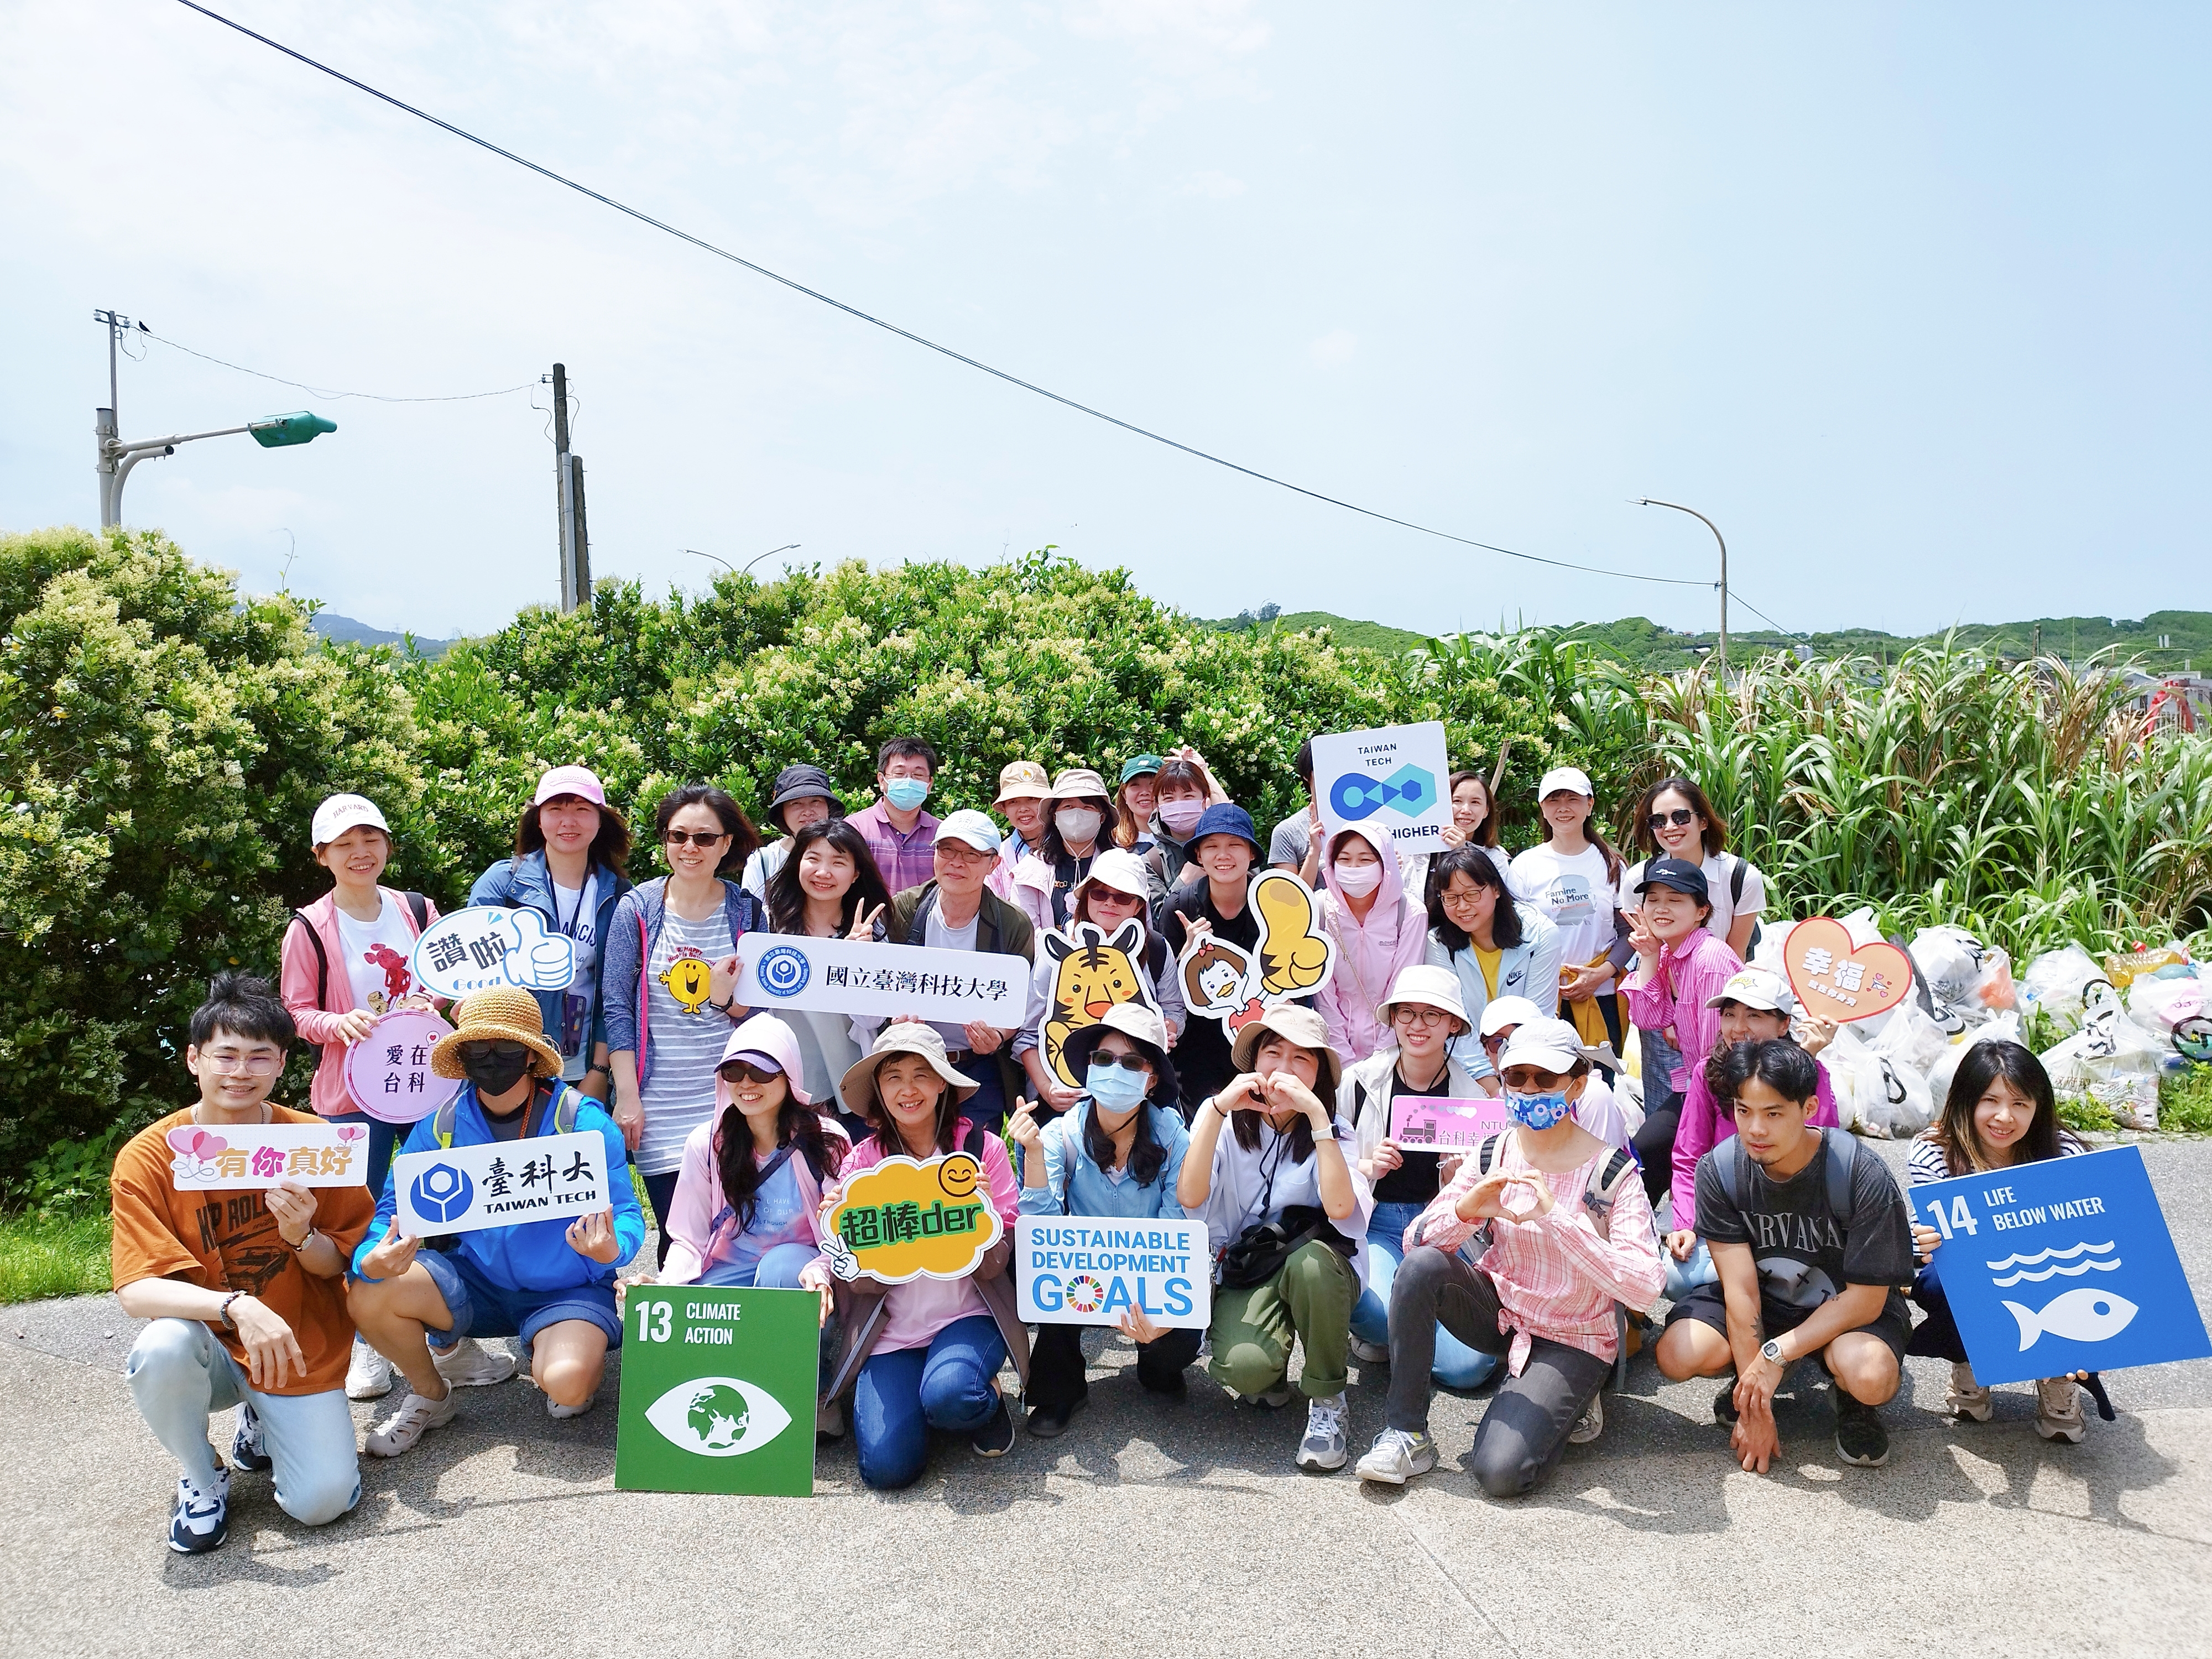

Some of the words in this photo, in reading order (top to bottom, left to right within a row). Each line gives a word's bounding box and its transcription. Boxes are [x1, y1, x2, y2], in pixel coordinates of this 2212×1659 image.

[1358, 743, 1397, 755] TAIWAN
[1365, 757, 1392, 767] TECH
[333, 804, 369, 819] HARVARD
[1545, 888, 1577, 899] Famine
[1551, 897, 1564, 906] No
[1567, 894, 1589, 902] More
[425, 931, 508, 972] 讚啦
[684, 946, 703, 956] HAPPY
[1508, 970, 1522, 980] NIKE
[1802, 947, 1866, 992] 幸福
[453, 977, 501, 991] Good
[826, 965, 1008, 1001] 國立臺灣科技大學
[385, 1044, 428, 1066] 愛在
[384, 1071, 425, 1093] 台科
[216, 1146, 353, 1177] 有你真好
[482, 1150, 594, 1198] 臺科大
[483, 1196, 549, 1214] TAIWAN
[554, 1190, 597, 1204] TECH
[1983, 1186, 2017, 1207] LIFE
[842, 1202, 982, 1247] 超棒der
[1926, 1195, 1978, 1240] 14
[1992, 1206, 2047, 1232] BELOW
[2048, 1197, 2106, 1221] WATER
[1031, 1228, 1190, 1250] SUSTAINABLE
[1739, 1211, 1844, 1253] NRVANA
[1032, 1251, 1191, 1273] DEVELOPMENT
[1032, 1274, 1193, 1316] GOALS
[635, 1301, 673, 1343] 13
[686, 1302, 742, 1321] CLIMATE
[684, 1327, 733, 1345] ACTION
